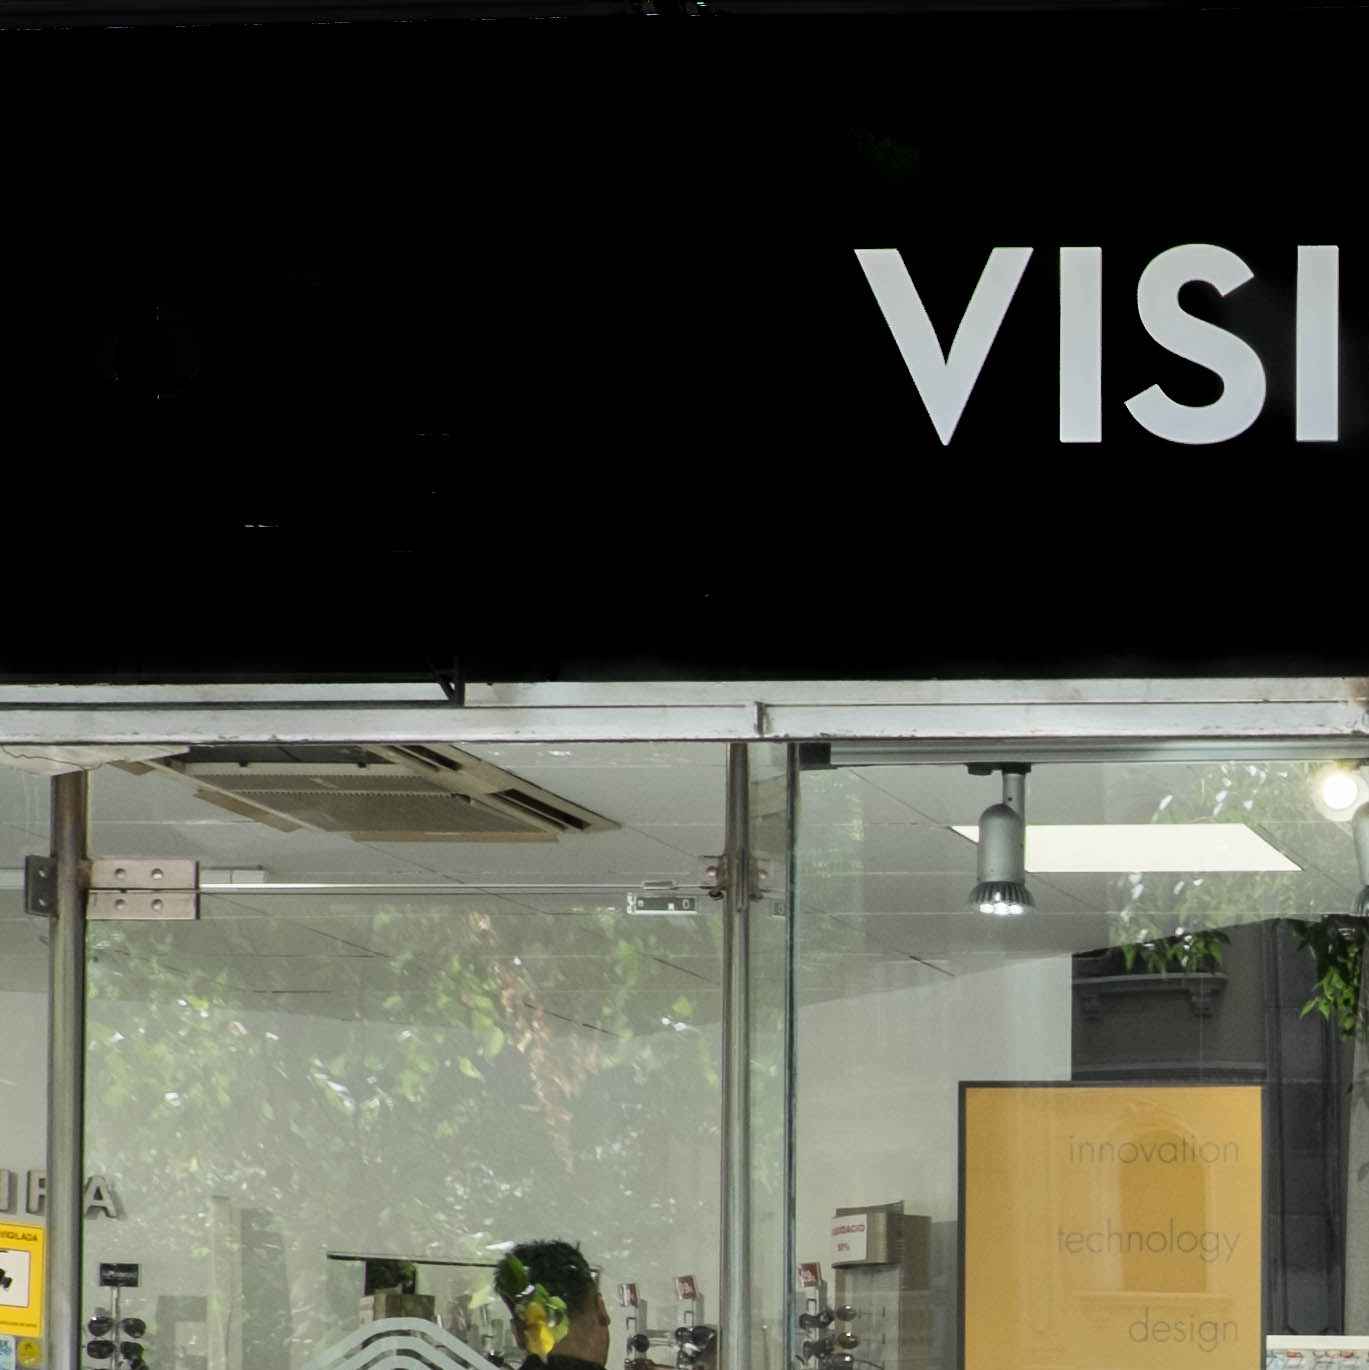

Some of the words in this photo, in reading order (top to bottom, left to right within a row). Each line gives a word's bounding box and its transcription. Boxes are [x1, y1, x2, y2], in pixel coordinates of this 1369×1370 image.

[1067, 1135, 1240, 1164] innovation
[1056, 1217, 1241, 1263] technology
[1128, 1305, 1239, 1353] design
